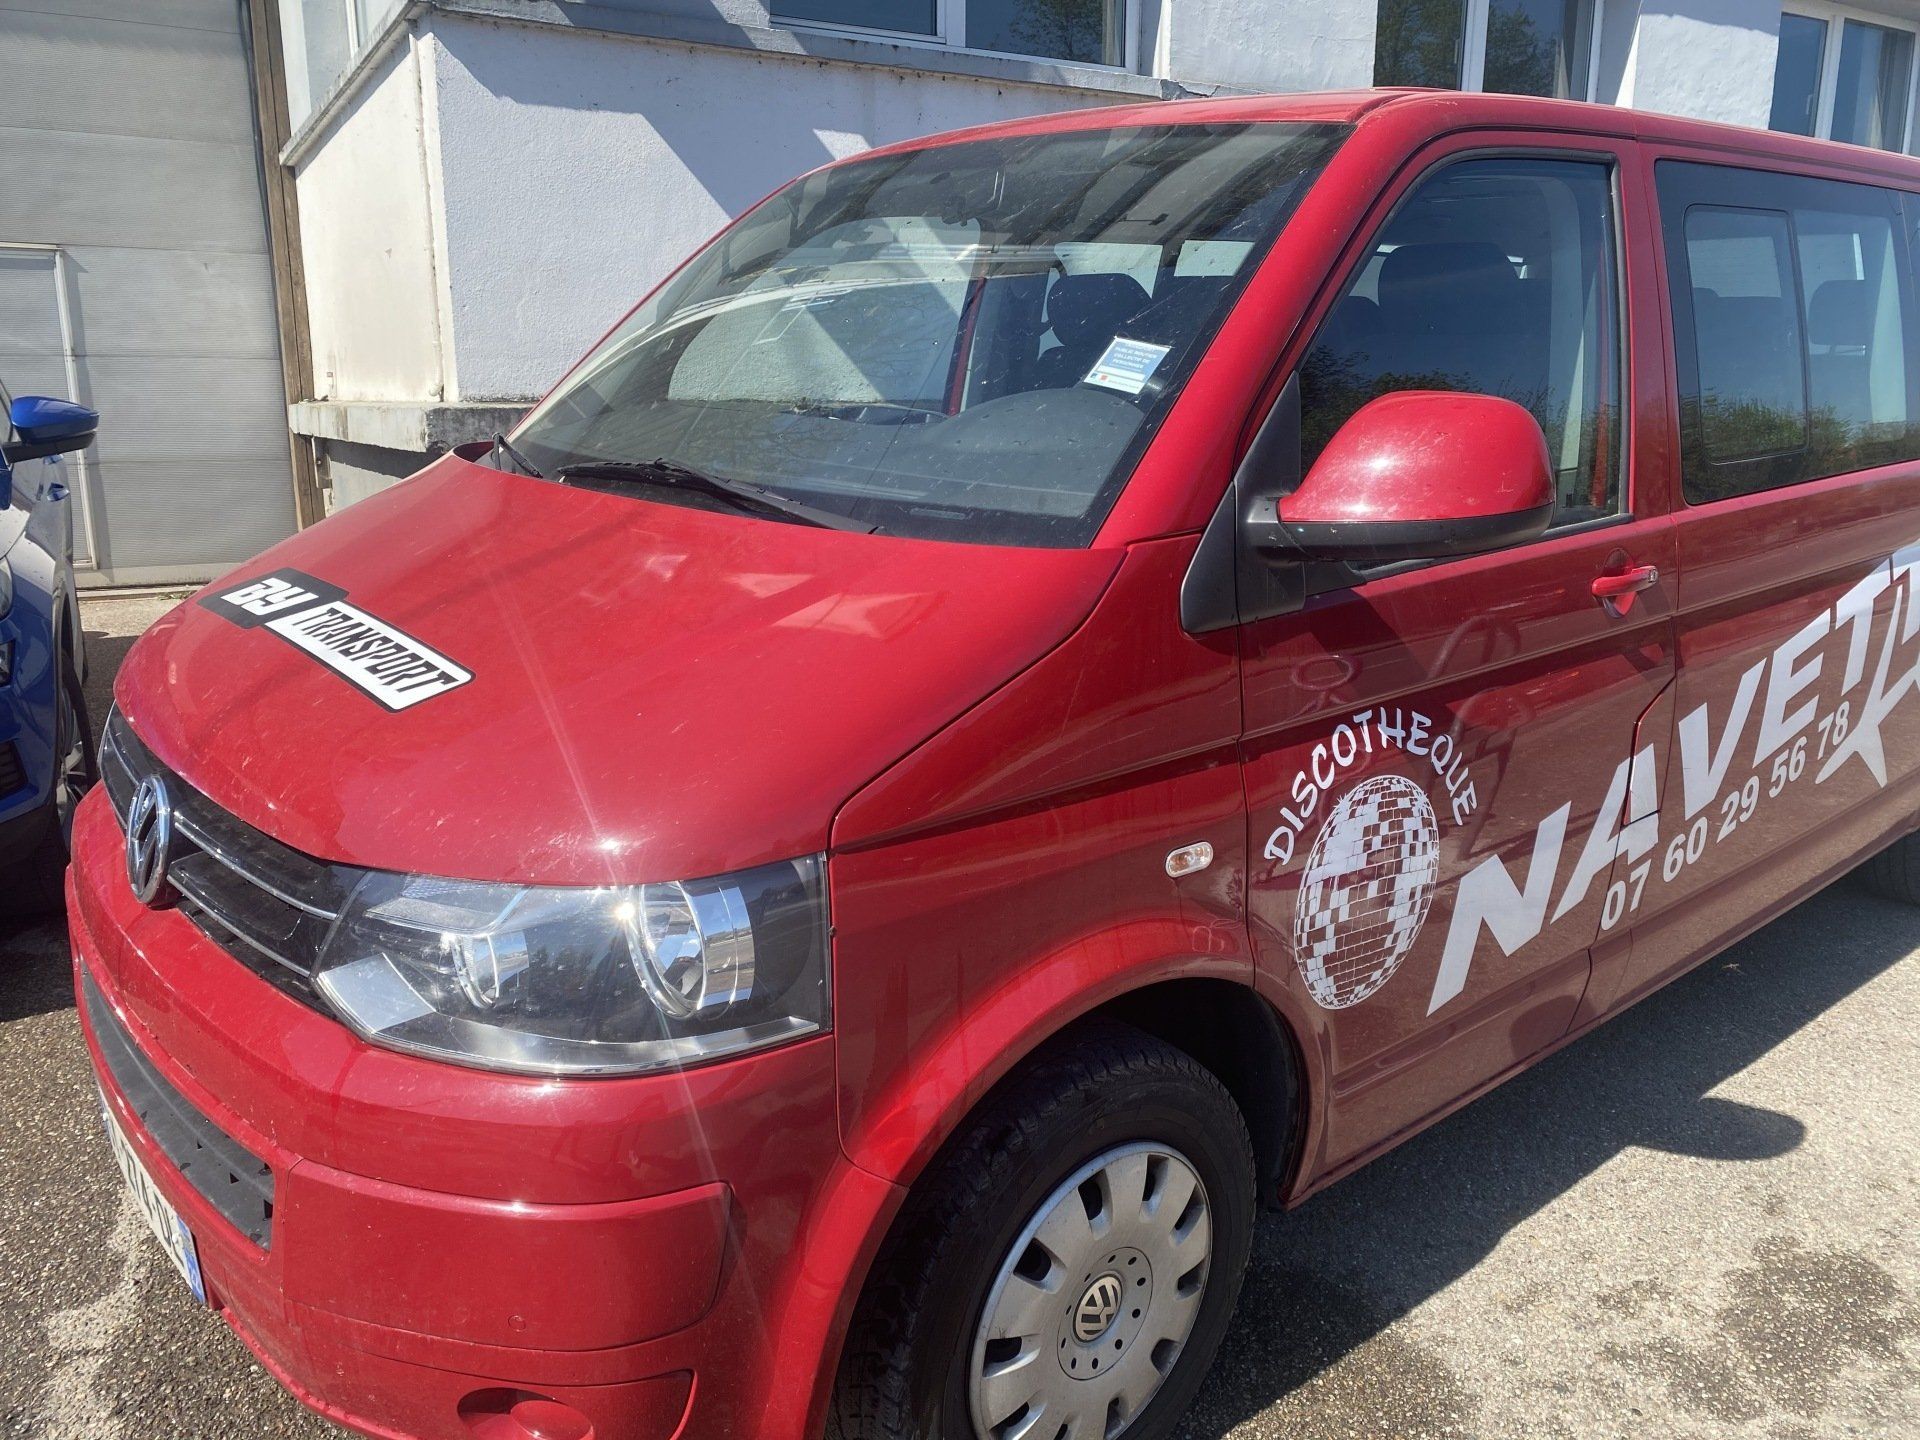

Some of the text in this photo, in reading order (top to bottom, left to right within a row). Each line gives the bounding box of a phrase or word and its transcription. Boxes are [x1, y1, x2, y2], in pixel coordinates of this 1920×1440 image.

[292, 607, 459, 693] TRANSPORT
[1264, 706, 1478, 865] DISCOTHEQUE
[1600, 700, 1850, 931] 07 60 29 56 78
